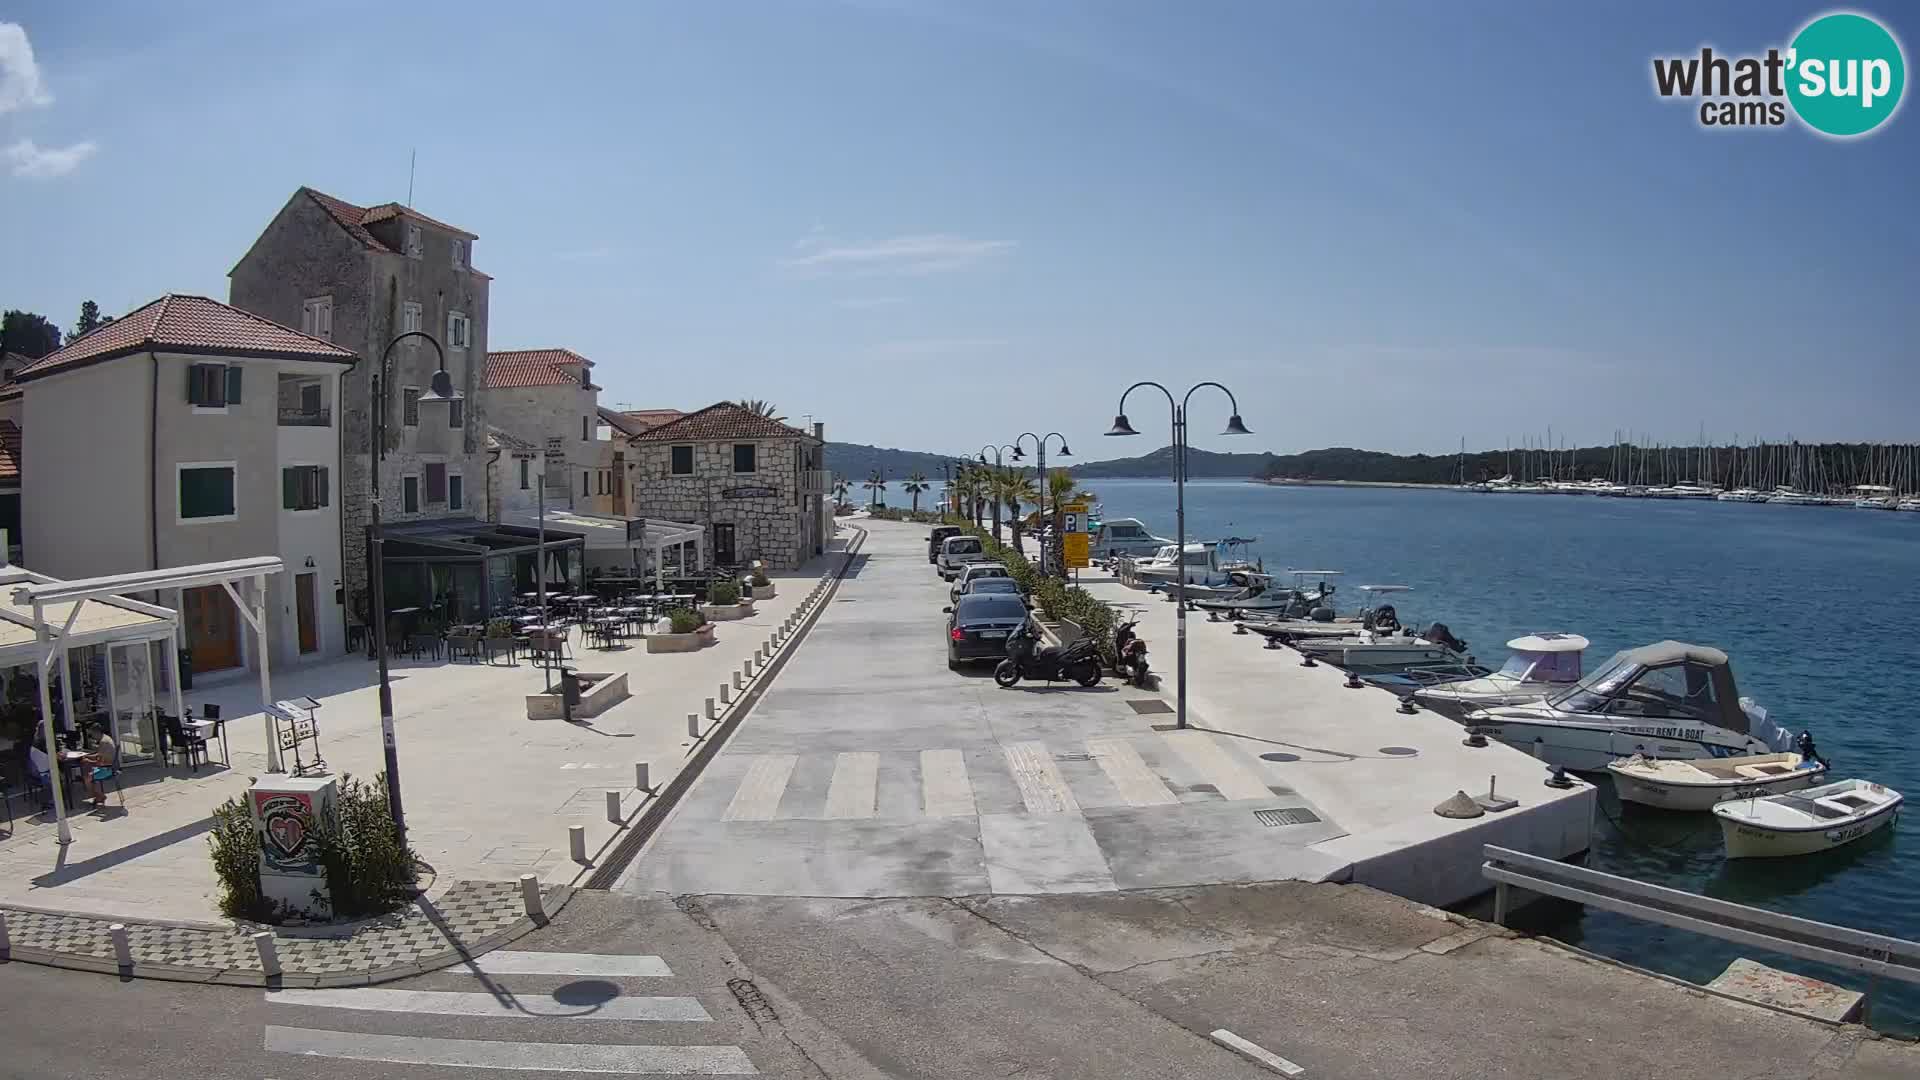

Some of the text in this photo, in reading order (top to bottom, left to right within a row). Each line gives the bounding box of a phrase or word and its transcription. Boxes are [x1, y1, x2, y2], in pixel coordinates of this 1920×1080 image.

[1065, 515, 1076, 530] P
[1656, 727, 1678, 737] RENT
[1678, 728, 1683, 737] A
[1685, 729, 1705, 741] BOAT
